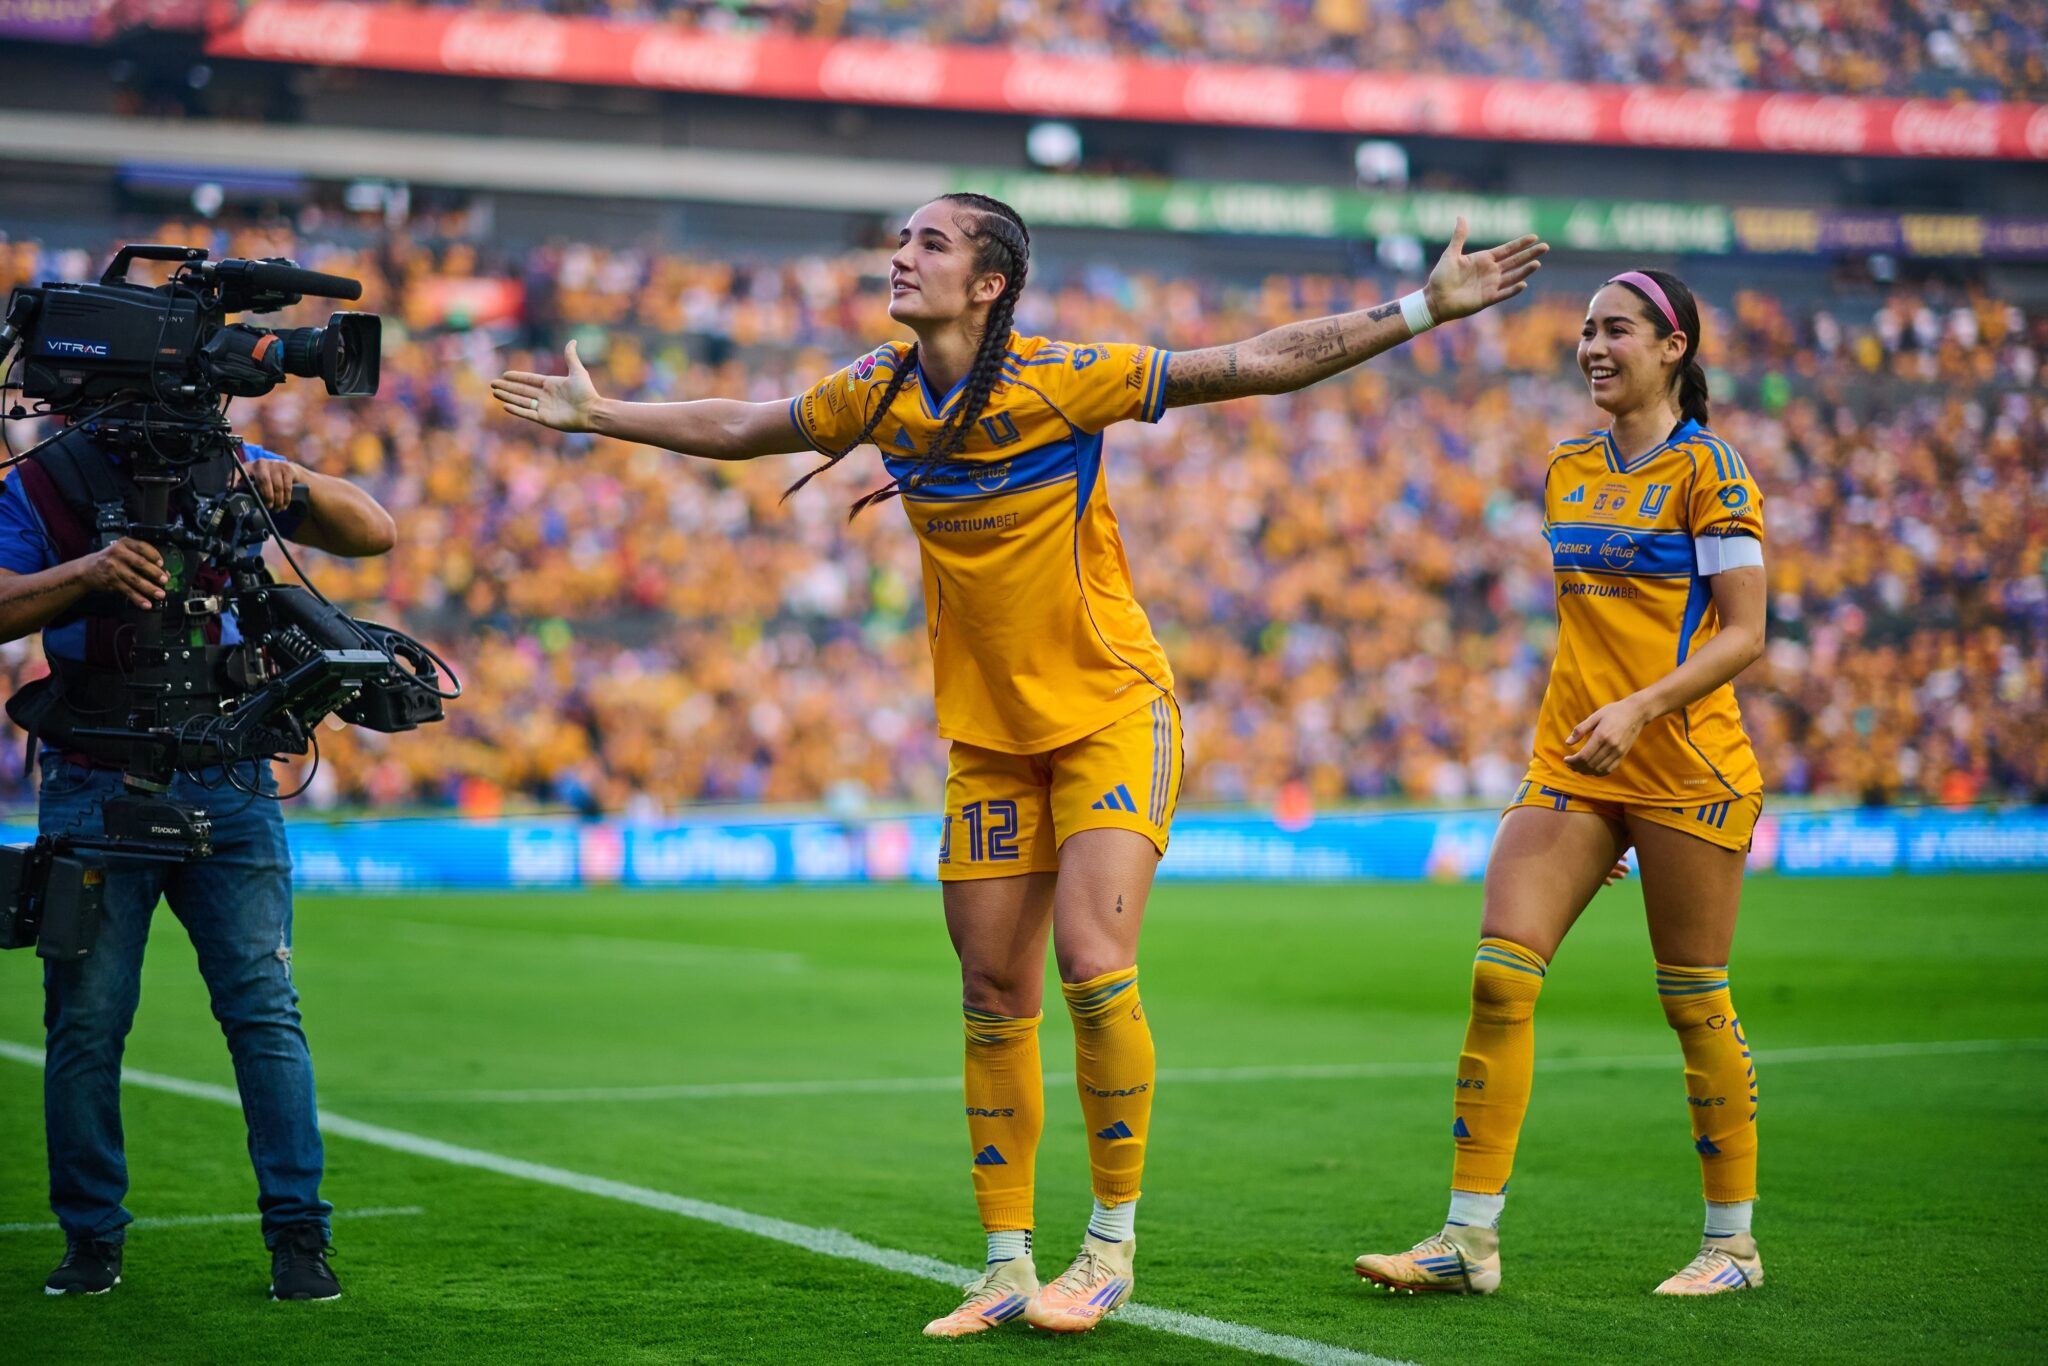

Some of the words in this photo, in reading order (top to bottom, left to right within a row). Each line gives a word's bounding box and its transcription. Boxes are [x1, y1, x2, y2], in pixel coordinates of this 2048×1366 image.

[47, 340, 107, 355] VITRAC
[805, 395, 817, 432] FUTURO
[927, 512, 1019, 535] SPORTIUMBET
[1559, 543, 1593, 555] CEMEX
[1599, 543, 1636, 559] Vertua
[962, 800, 1020, 862] 12
